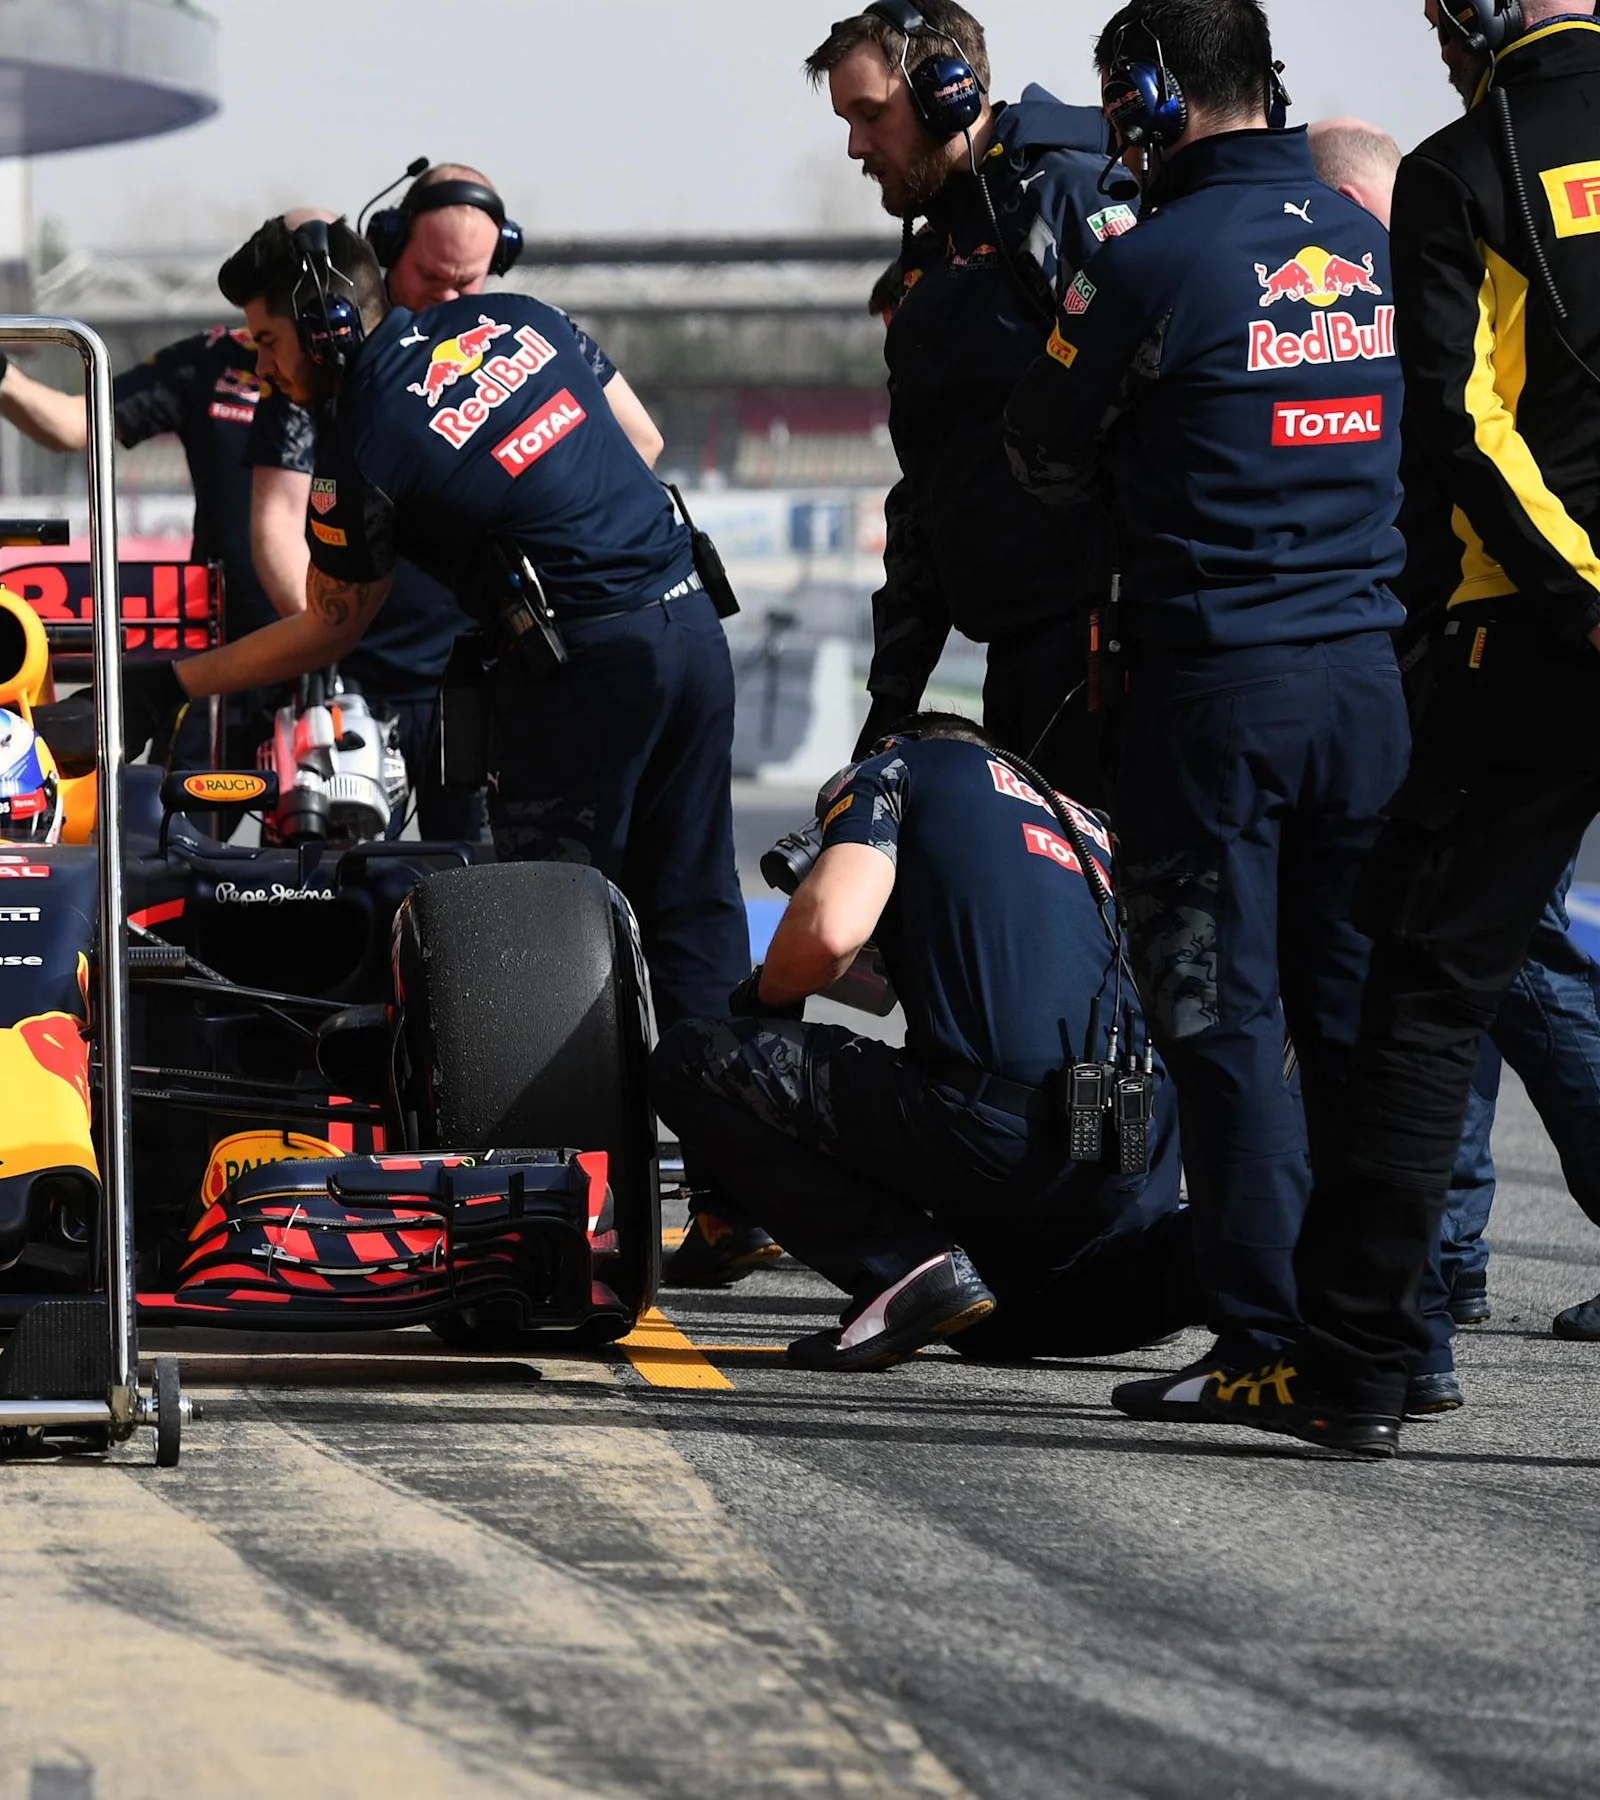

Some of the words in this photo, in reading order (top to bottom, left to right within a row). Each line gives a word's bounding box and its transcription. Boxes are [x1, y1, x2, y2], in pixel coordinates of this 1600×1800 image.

[1092, 208, 1130, 229] TAG
[1249, 312, 1331, 370] Red
[1328, 306, 1395, 361] Bull
[431, 370, 510, 448] Red
[485, 327, 555, 390] Bull
[498, 403, 582, 464] TOTAL
[1277, 408, 1381, 438] TOTAL
[206, 779, 256, 791] RAUCH
[215, 882, 268, 906] Pepe
[268, 883, 336, 905] Jeans
